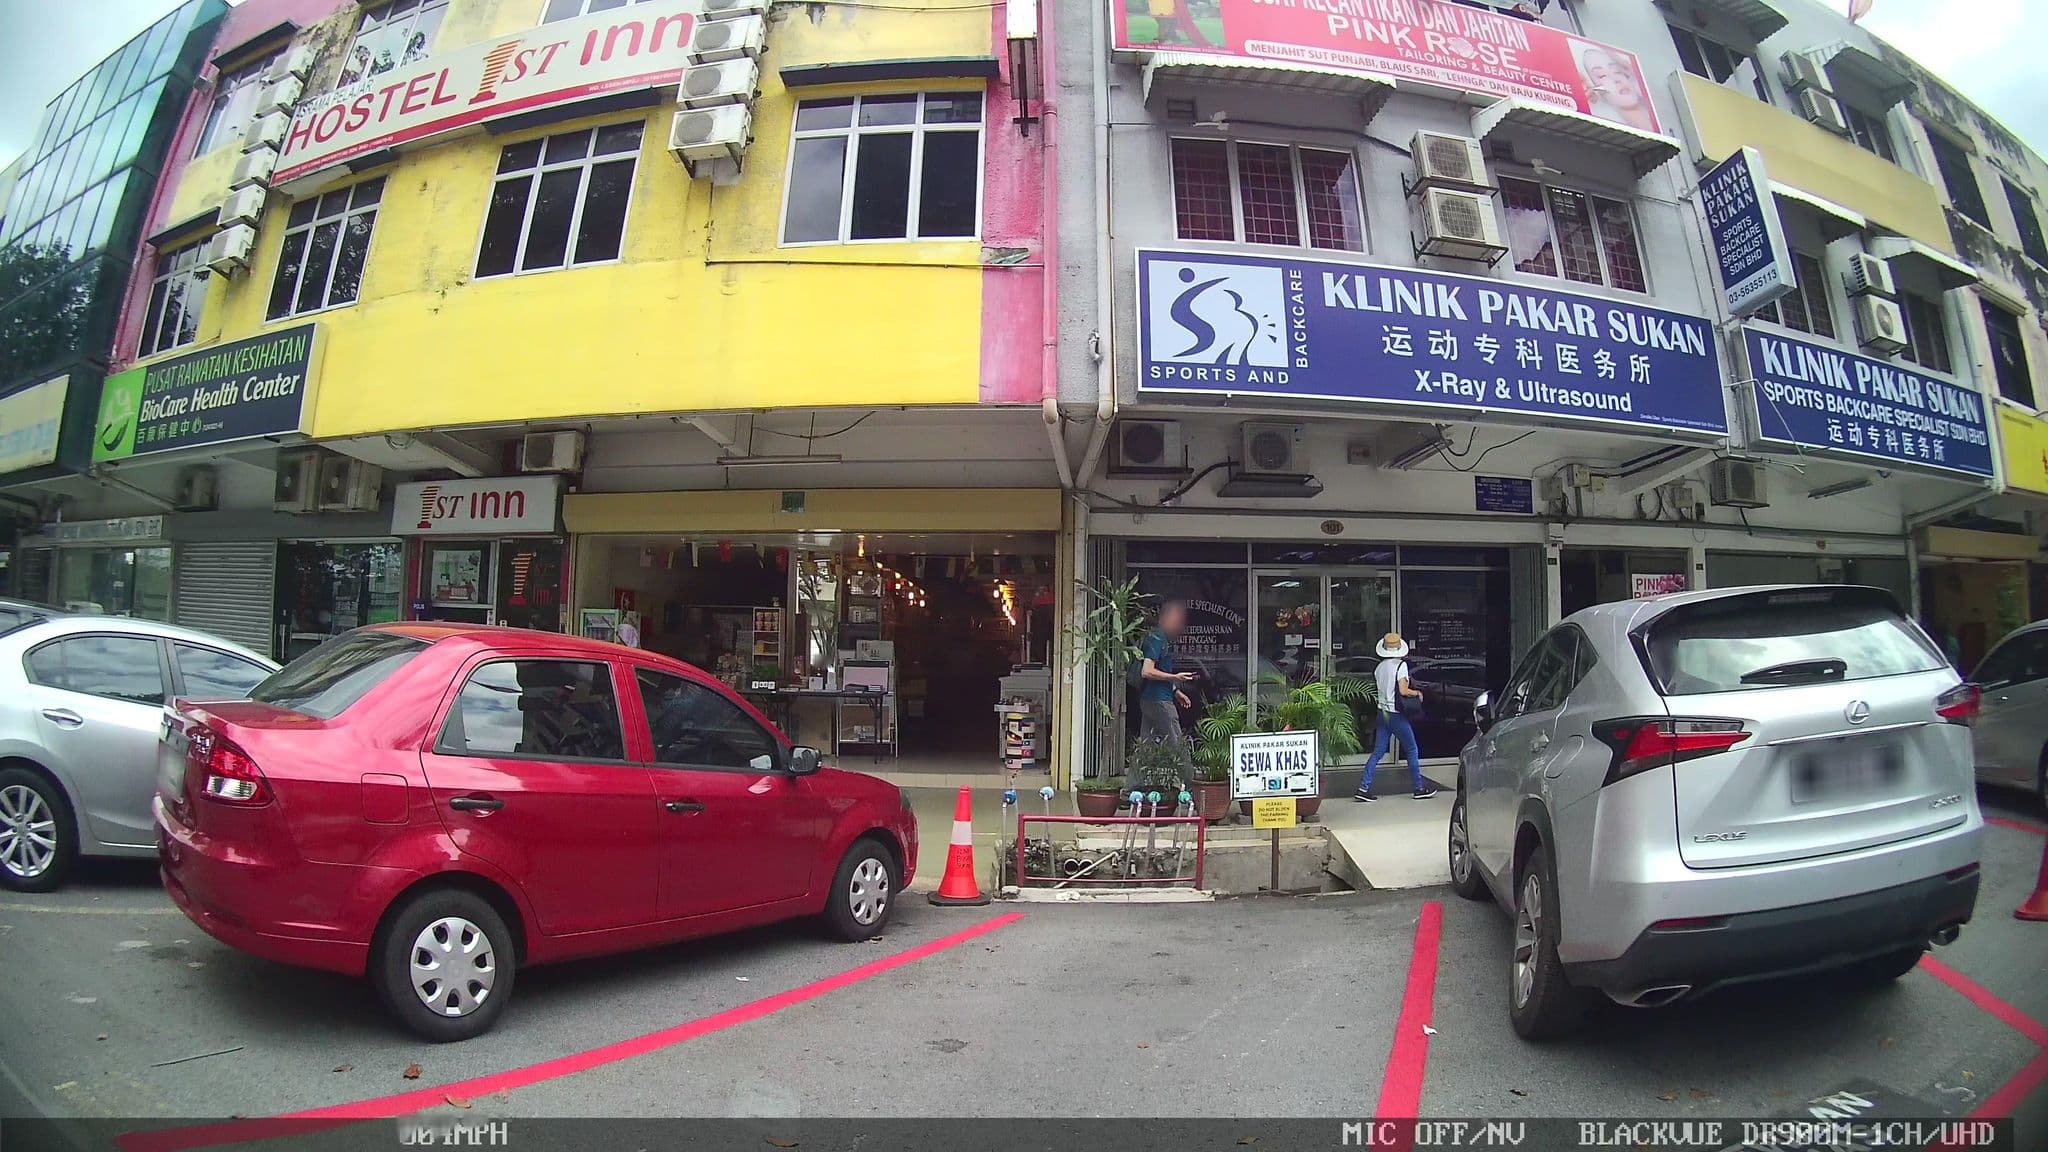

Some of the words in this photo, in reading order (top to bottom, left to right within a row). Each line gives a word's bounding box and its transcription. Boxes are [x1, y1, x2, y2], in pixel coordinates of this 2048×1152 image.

[1327, 13, 1416, 49] PINK
[1418, 2, 1460, 36] DAN
[1459, 10, 1531, 53] JAHITAN
[1251, 43, 1306, 57] MENJAHIT
[1308, 51, 1330, 61] SUT
[1380, 61, 1412, 74] BLAUS
[1489, 82, 1510, 93] DAN
[1511, 85, 1533, 99] BAJU
[1397, 47, 1468, 69] TAILORING
[1471, 62, 1481, 72] &
[1484, 65, 1527, 82] BEAUTY
[1529, 75, 1573, 94] CENTRE
[284, 68, 457, 156] HOSTEL
[1701, 160, 1747, 202] KLINIK
[1707, 175, 1751, 215] PAKAR
[1710, 189, 1754, 229] SUKAN
[1722, 216, 1753, 242] SPORTS
[1720, 223, 1762, 255] BACKCARE
[1722, 234, 1765, 267] SPECIALIST
[1730, 261, 1746, 276] SDN
[1747, 249, 1763, 266] BHD
[1728, 269, 1777, 304] 03-56355113
[1290, 269, 1308, 368] BACKCARE
[1322, 272, 1468, 321] KLINIK
[1478, 289, 1598, 339] PAKAR
[1608, 308, 1706, 357] SUKAN
[145, 366, 178, 395] PUSAT
[177, 353, 229, 387] RAWATAN
[232, 334, 307, 375] KESIHATAN
[1150, 365, 1237, 382] SPORTS
[1248, 368, 1289, 384] AND
[1382, 324, 1651, 385] 运动专科医务所
[140, 395, 188, 422] BioCare
[190, 381, 238, 413] Health
[242, 372, 300, 402] Center
[1414, 369, 1486, 402] X-Ray
[1495, 377, 1511, 399] &
[1517, 378, 1632, 413] Ultrasound
[1760, 337, 1853, 391] KLINIK
[1854, 361, 1924, 409] PAKAR
[1925, 381, 1980, 424] SUKAN
[1763, 380, 1824, 410] SPORTS
[1825, 393, 1894, 425] BACKCARE
[1894, 408, 1950, 437] SPECIALIST
[1950, 422, 1968, 442] SDN
[1968, 428, 1987, 446] BHD
[1827, 418, 1945, 462] 运动专科医务所
[1195, 600, 1227, 617] SPECIALIST
[1225, 609, 1245, 627] CLINIC
[1188, 636, 1216, 644] PINGGANG
[1240, 752, 1272, 772] SEWA
[1276, 750, 1307, 771] KHAS
[1694, 830, 1748, 843] LEXUS
